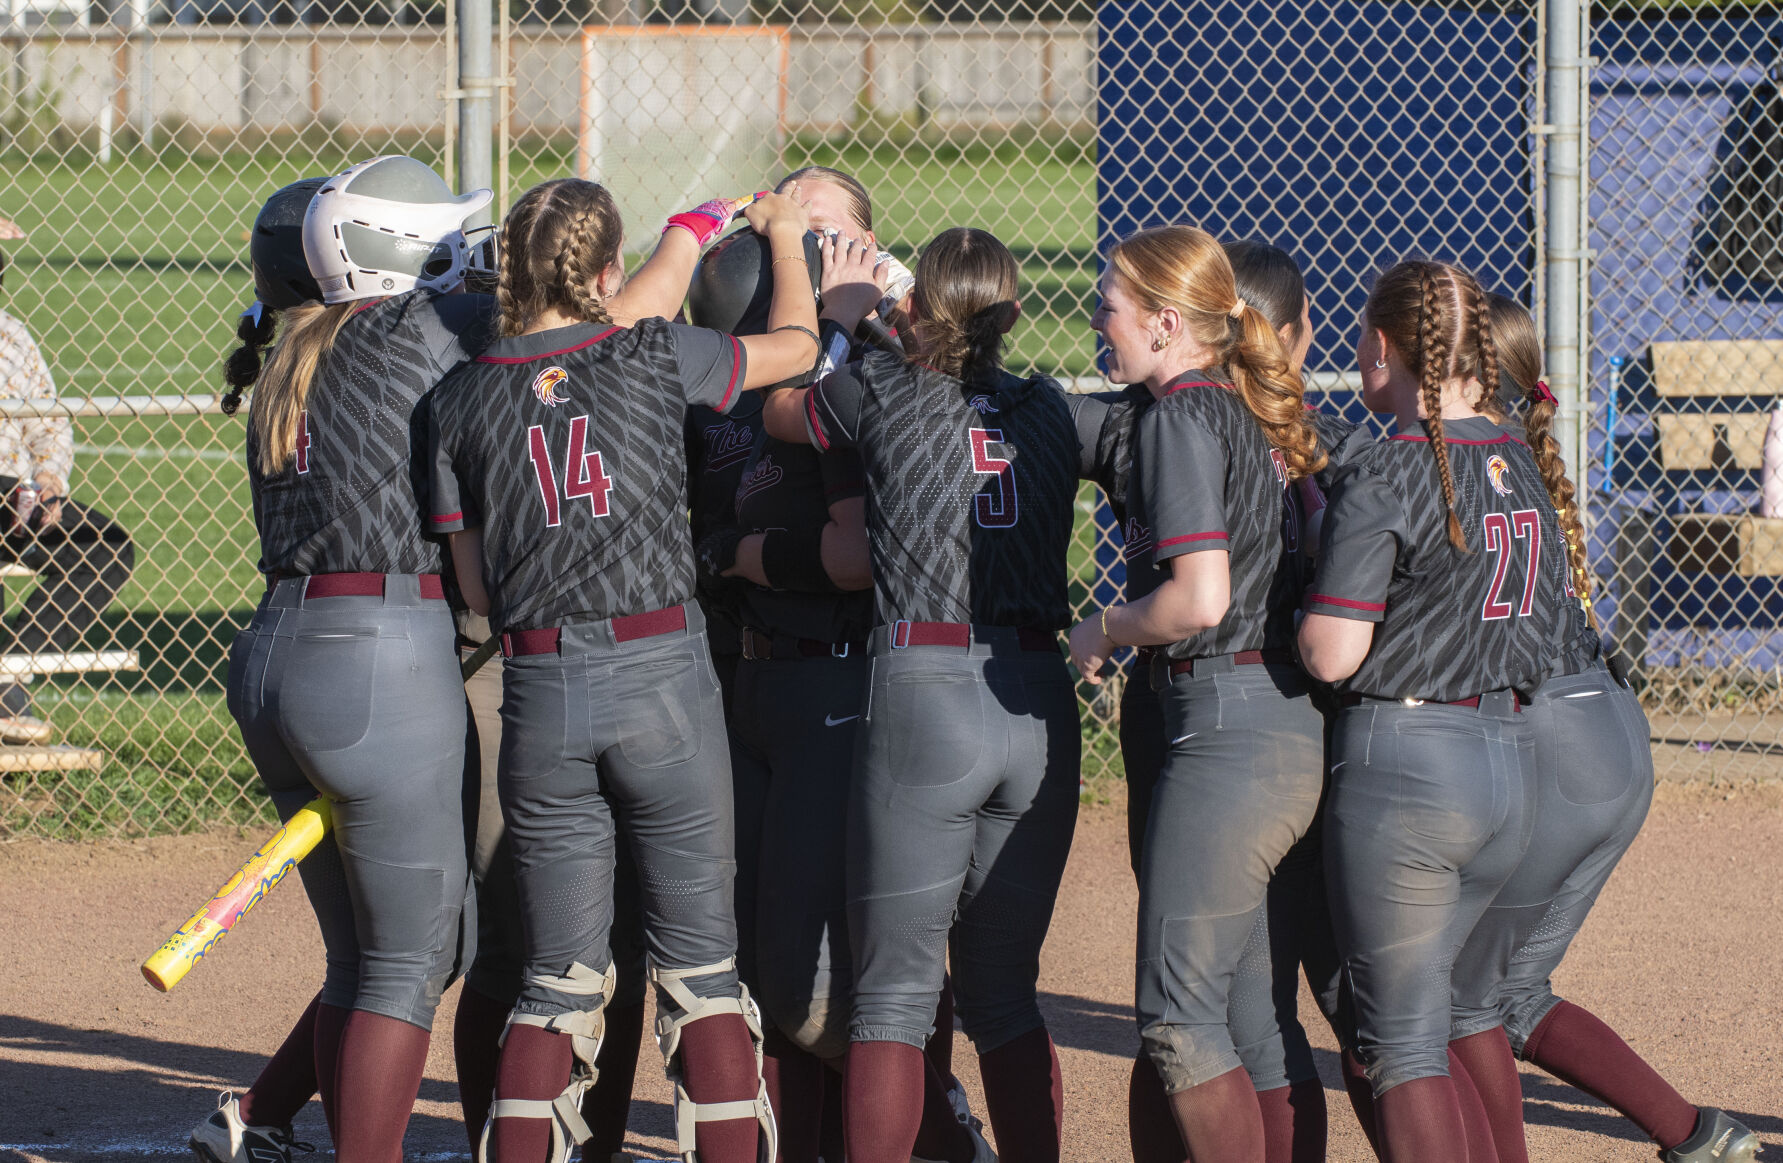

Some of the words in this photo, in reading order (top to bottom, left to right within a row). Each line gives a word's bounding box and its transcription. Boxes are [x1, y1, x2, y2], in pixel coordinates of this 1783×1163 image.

[528, 415, 613, 528] 14
[969, 428, 1018, 529] 5
[1482, 508, 1541, 621] 27
